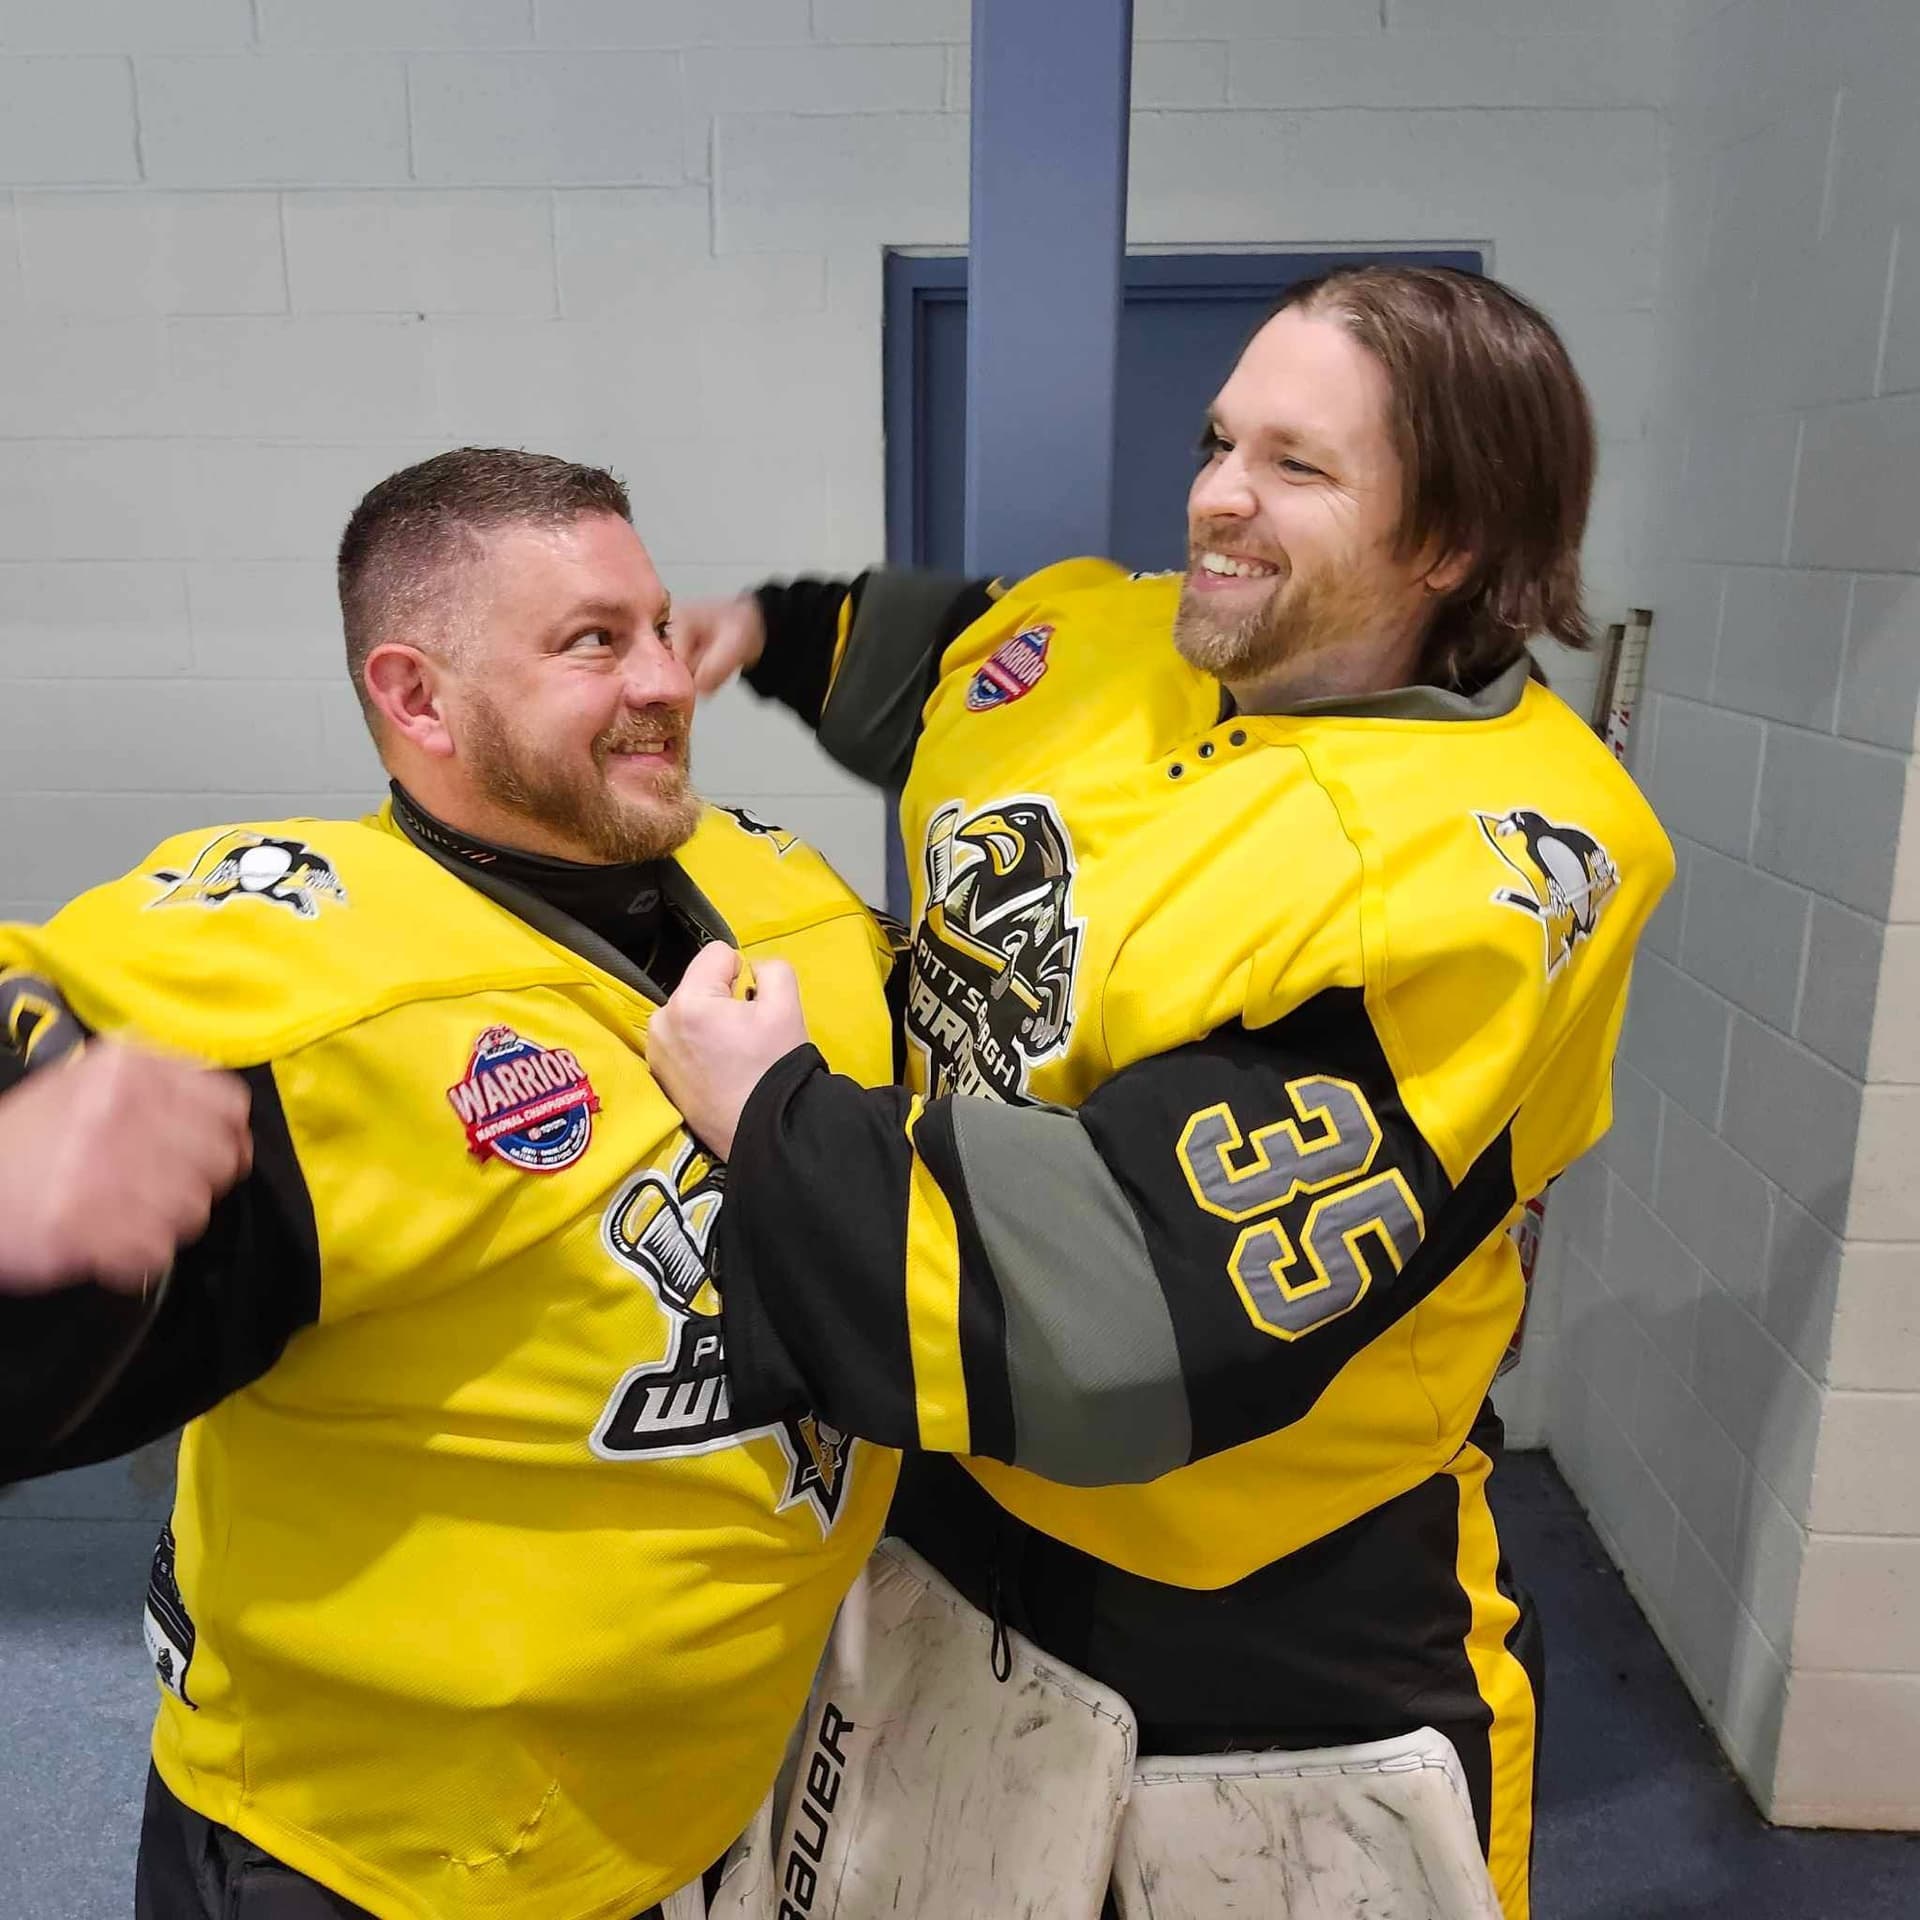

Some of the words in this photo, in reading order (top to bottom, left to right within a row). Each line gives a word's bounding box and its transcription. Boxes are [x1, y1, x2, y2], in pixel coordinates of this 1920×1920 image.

[450, 1050, 585, 1125] WARRIOR
[475, 1114, 525, 1143] NATIONAL
[1176, 1074, 1425, 1343] 35
